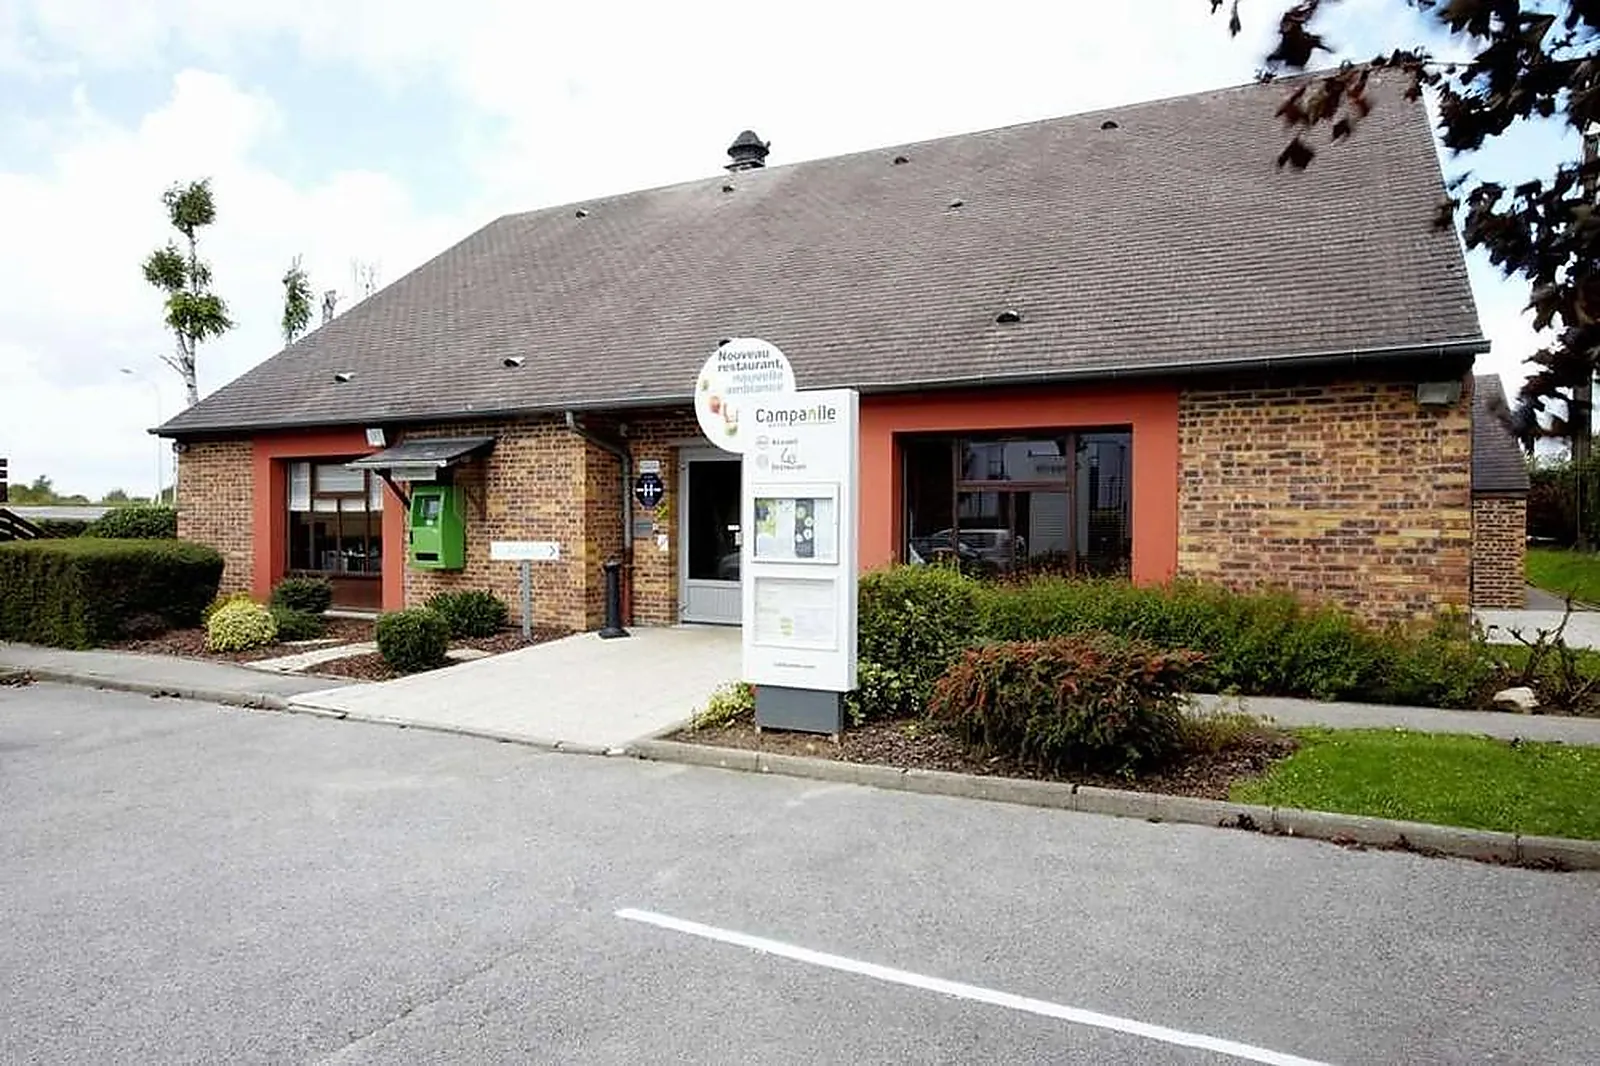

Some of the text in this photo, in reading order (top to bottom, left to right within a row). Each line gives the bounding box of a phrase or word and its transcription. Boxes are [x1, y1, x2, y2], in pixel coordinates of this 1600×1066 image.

[718, 350, 769, 361] Nouveau
[718, 359, 783, 372] restaurant,
[756, 404, 836, 426] Campanile
